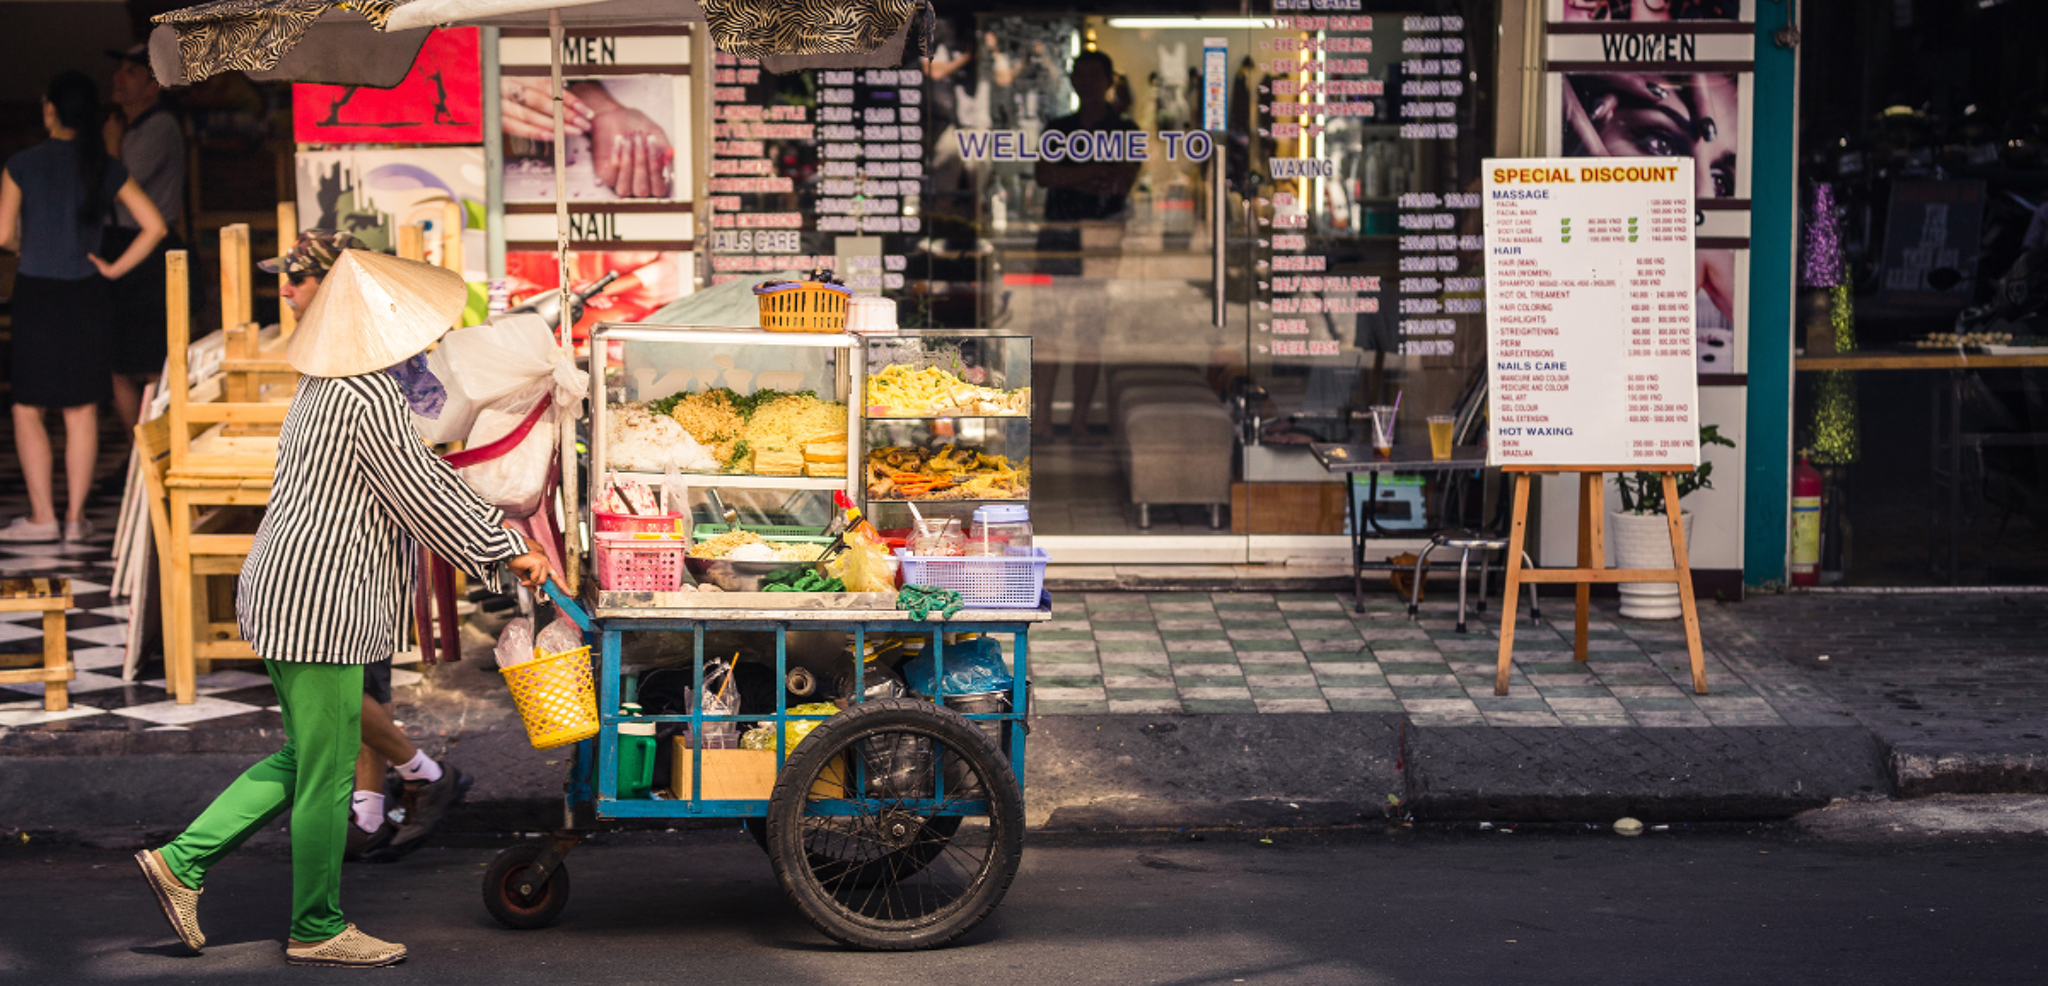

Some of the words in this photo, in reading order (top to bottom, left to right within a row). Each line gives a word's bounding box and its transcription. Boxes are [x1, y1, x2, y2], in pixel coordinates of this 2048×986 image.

[1329, 16, 1373, 31] COLOUR
[563, 38, 615, 64] MEN
[1273, 37, 1293, 52] EYE
[1296, 37, 1324, 52] LASH
[1326, 37, 1372, 52] CURLING
[1602, 34, 1696, 61] WOMEN
[1272, 59, 1293, 74] EYE
[1296, 59, 1324, 74] LASH
[1326, 59, 1368, 74] COLOUR
[1271, 80, 1292, 95] EYE
[1296, 80, 1324, 95] LASH
[1326, 80, 1384, 95] EXTENSION
[1271, 102, 1292, 116] EYE
[1327, 102, 1374, 116] SHAPING
[955, 130, 1149, 162] WELCOME
[1159, 130, 1213, 162] TO
[1269, 157, 1333, 178] WAXING
[1493, 167, 1575, 183] SPECIAL
[1581, 167, 1678, 183] DISCOUNT
[1493, 190, 1548, 199] MASSAGE
[569, 213, 622, 239] NAIL
[754, 231, 800, 253] CARE
[1517, 259, 1538, 267] (MAN)
[1498, 269, 1516, 277] HAIR
[1515, 269, 1551, 277] (WOMEN)
[1272, 277, 1299, 291] HALF
[1301, 277, 1323, 291] AND
[1351, 277, 1380, 291] BACK
[1499, 290, 1514, 299] HOT
[1516, 290, 1528, 299] OIL
[1272, 298, 1299, 313] HALF
[1301, 298, 1323, 313] AND
[1351, 298, 1379, 313] LEGS
[1499, 303, 1516, 311] HAIR
[1517, 303, 1553, 312] COLORING
[1272, 319, 1308, 334] FACIAL
[1500, 315, 1547, 324] HIGHLIGHTS
[1272, 341, 1307, 355] FACIAL
[1309, 341, 1339, 355] MASK
[1500, 339, 1521, 347] PERM
[1497, 362, 1531, 370] NAILS
[1535, 362, 1566, 370] CARE
[1502, 404, 1515, 412] GEL
[1514, 404, 1538, 412] COLOUR
